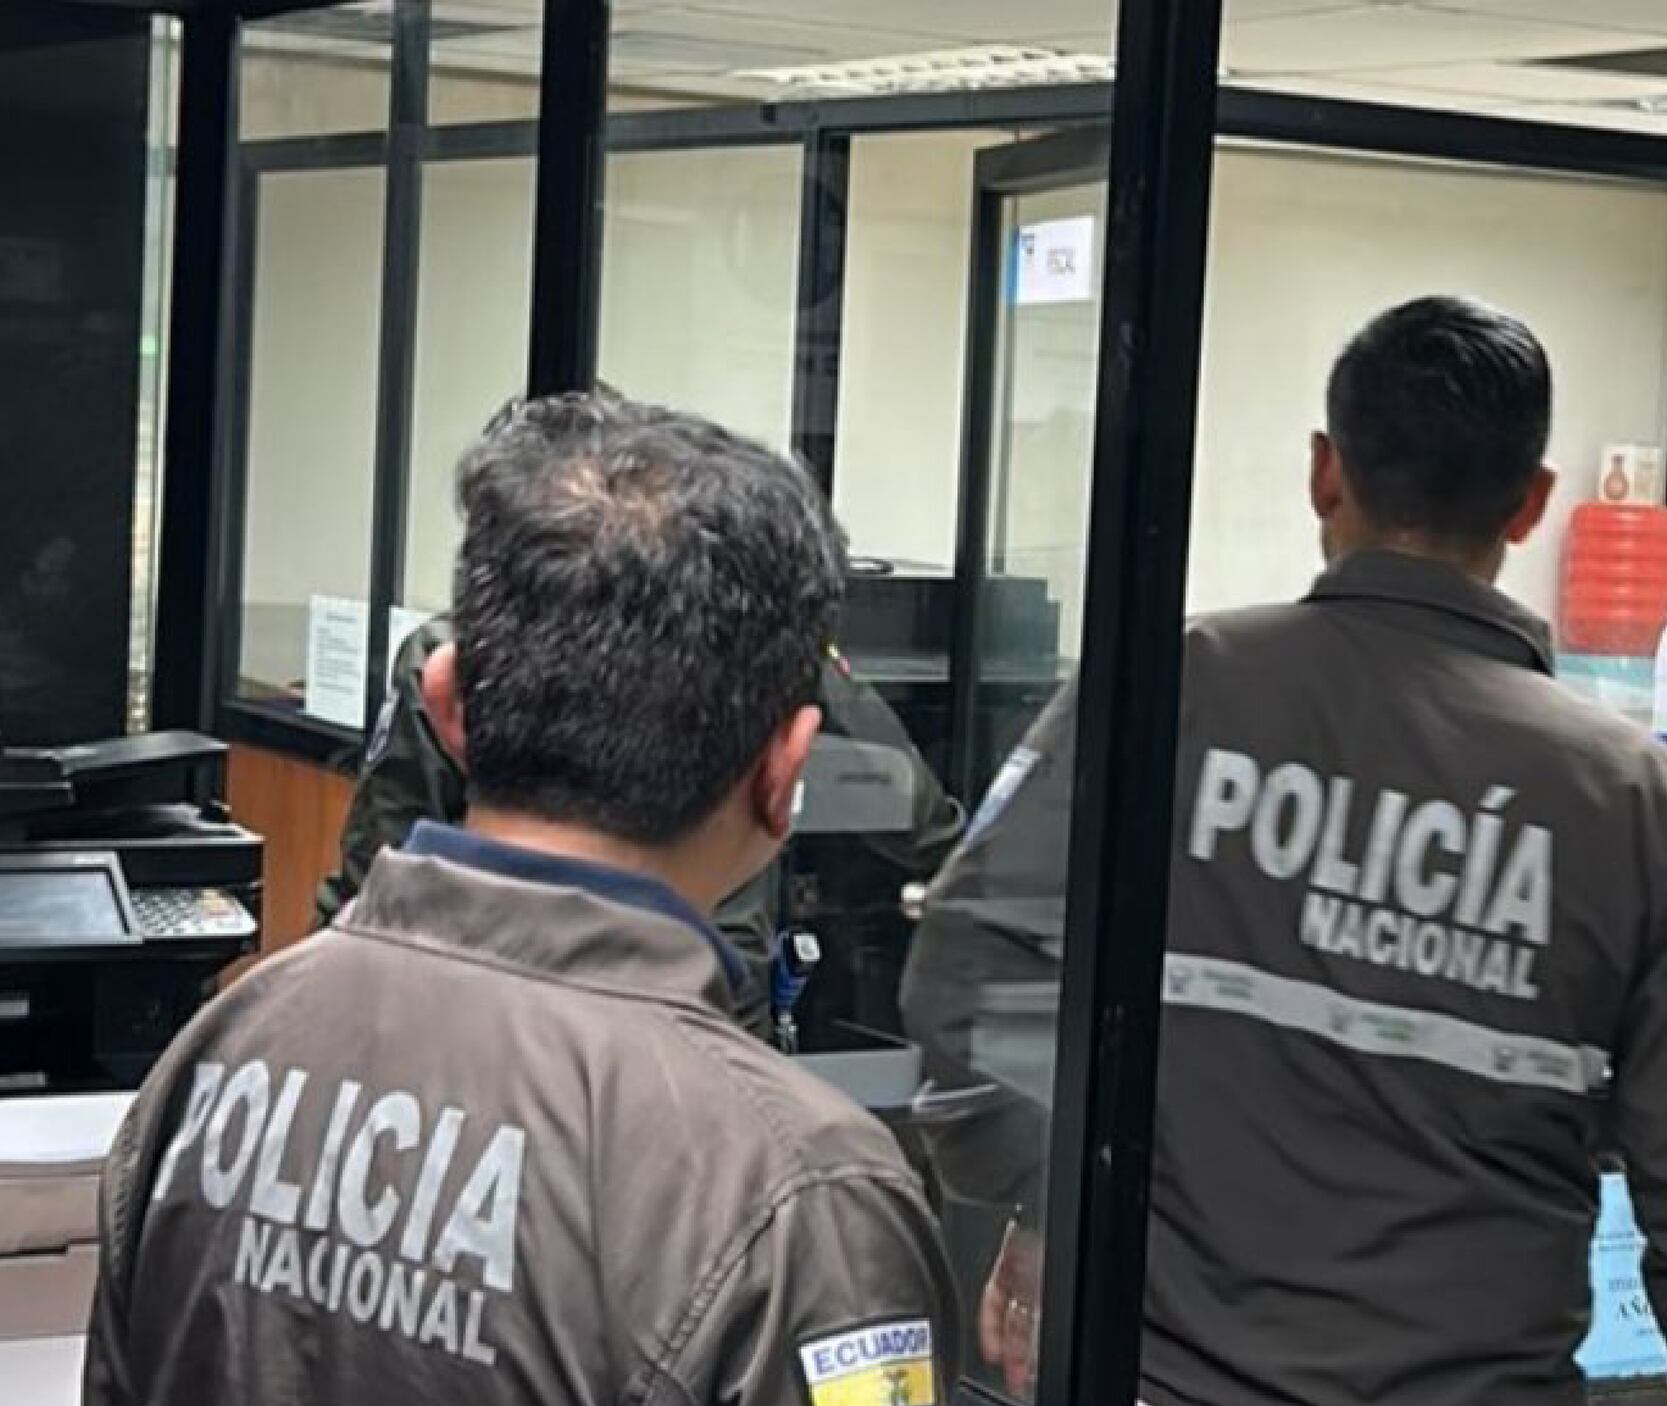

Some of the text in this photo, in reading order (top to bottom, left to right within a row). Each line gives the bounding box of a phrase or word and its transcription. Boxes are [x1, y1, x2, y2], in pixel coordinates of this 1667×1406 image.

[1188, 768, 1554, 947] POLICÍA
[1300, 892, 1541, 1001] NACIONAL
[152, 1059, 526, 1293] POLICIA
[234, 1216, 497, 1366] NACIONAL
[812, 1326, 930, 1375] ECUADOR
